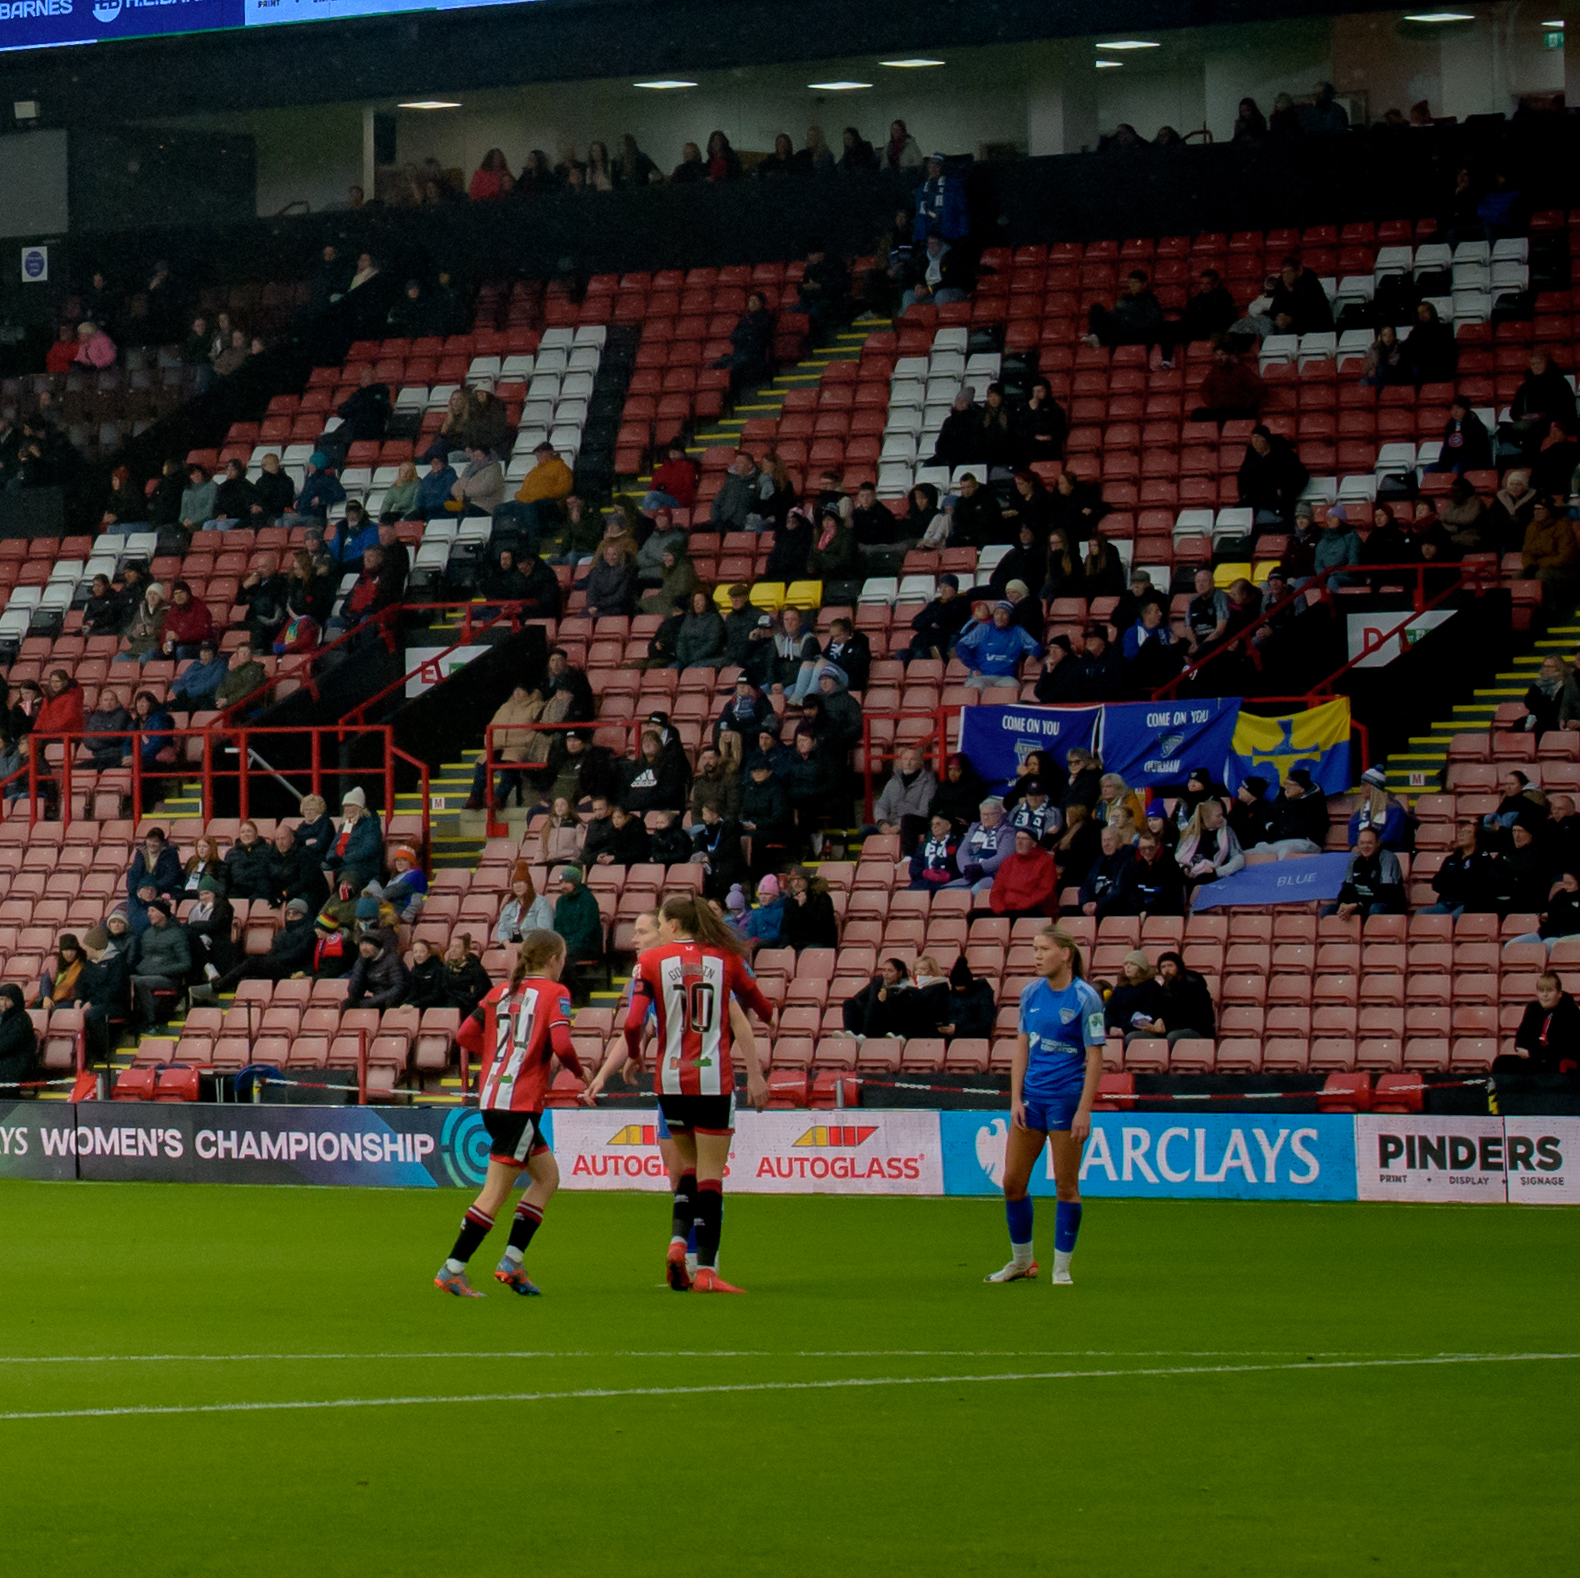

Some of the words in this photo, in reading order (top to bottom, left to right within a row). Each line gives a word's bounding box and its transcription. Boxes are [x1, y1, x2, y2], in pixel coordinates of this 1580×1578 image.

[1363, 627, 1384, 652] D
[1002, 715, 1026, 732] COME
[1026, 718, 1040, 733] ON
[1042, 720, 1060, 736] YOU
[1146, 712, 1170, 727] COME
[1173, 712, 1187, 726] ON
[1191, 709, 1209, 724] YOU
[1277, 873, 1317, 887] BLUE
[40, 1127, 183, 1157] WOMEN'S
[195, 1129, 435, 1163] CHAMPIONSHIP
[1045, 1127, 1320, 1184] ARCLAYS
[1378, 1134, 1563, 1171] PINDERS
[1380, 1174, 1407, 1183] PRINT
[1449, 1176, 1489, 1185] DISPLAY
[1520, 1177, 1565, 1186] SIGNAGE
